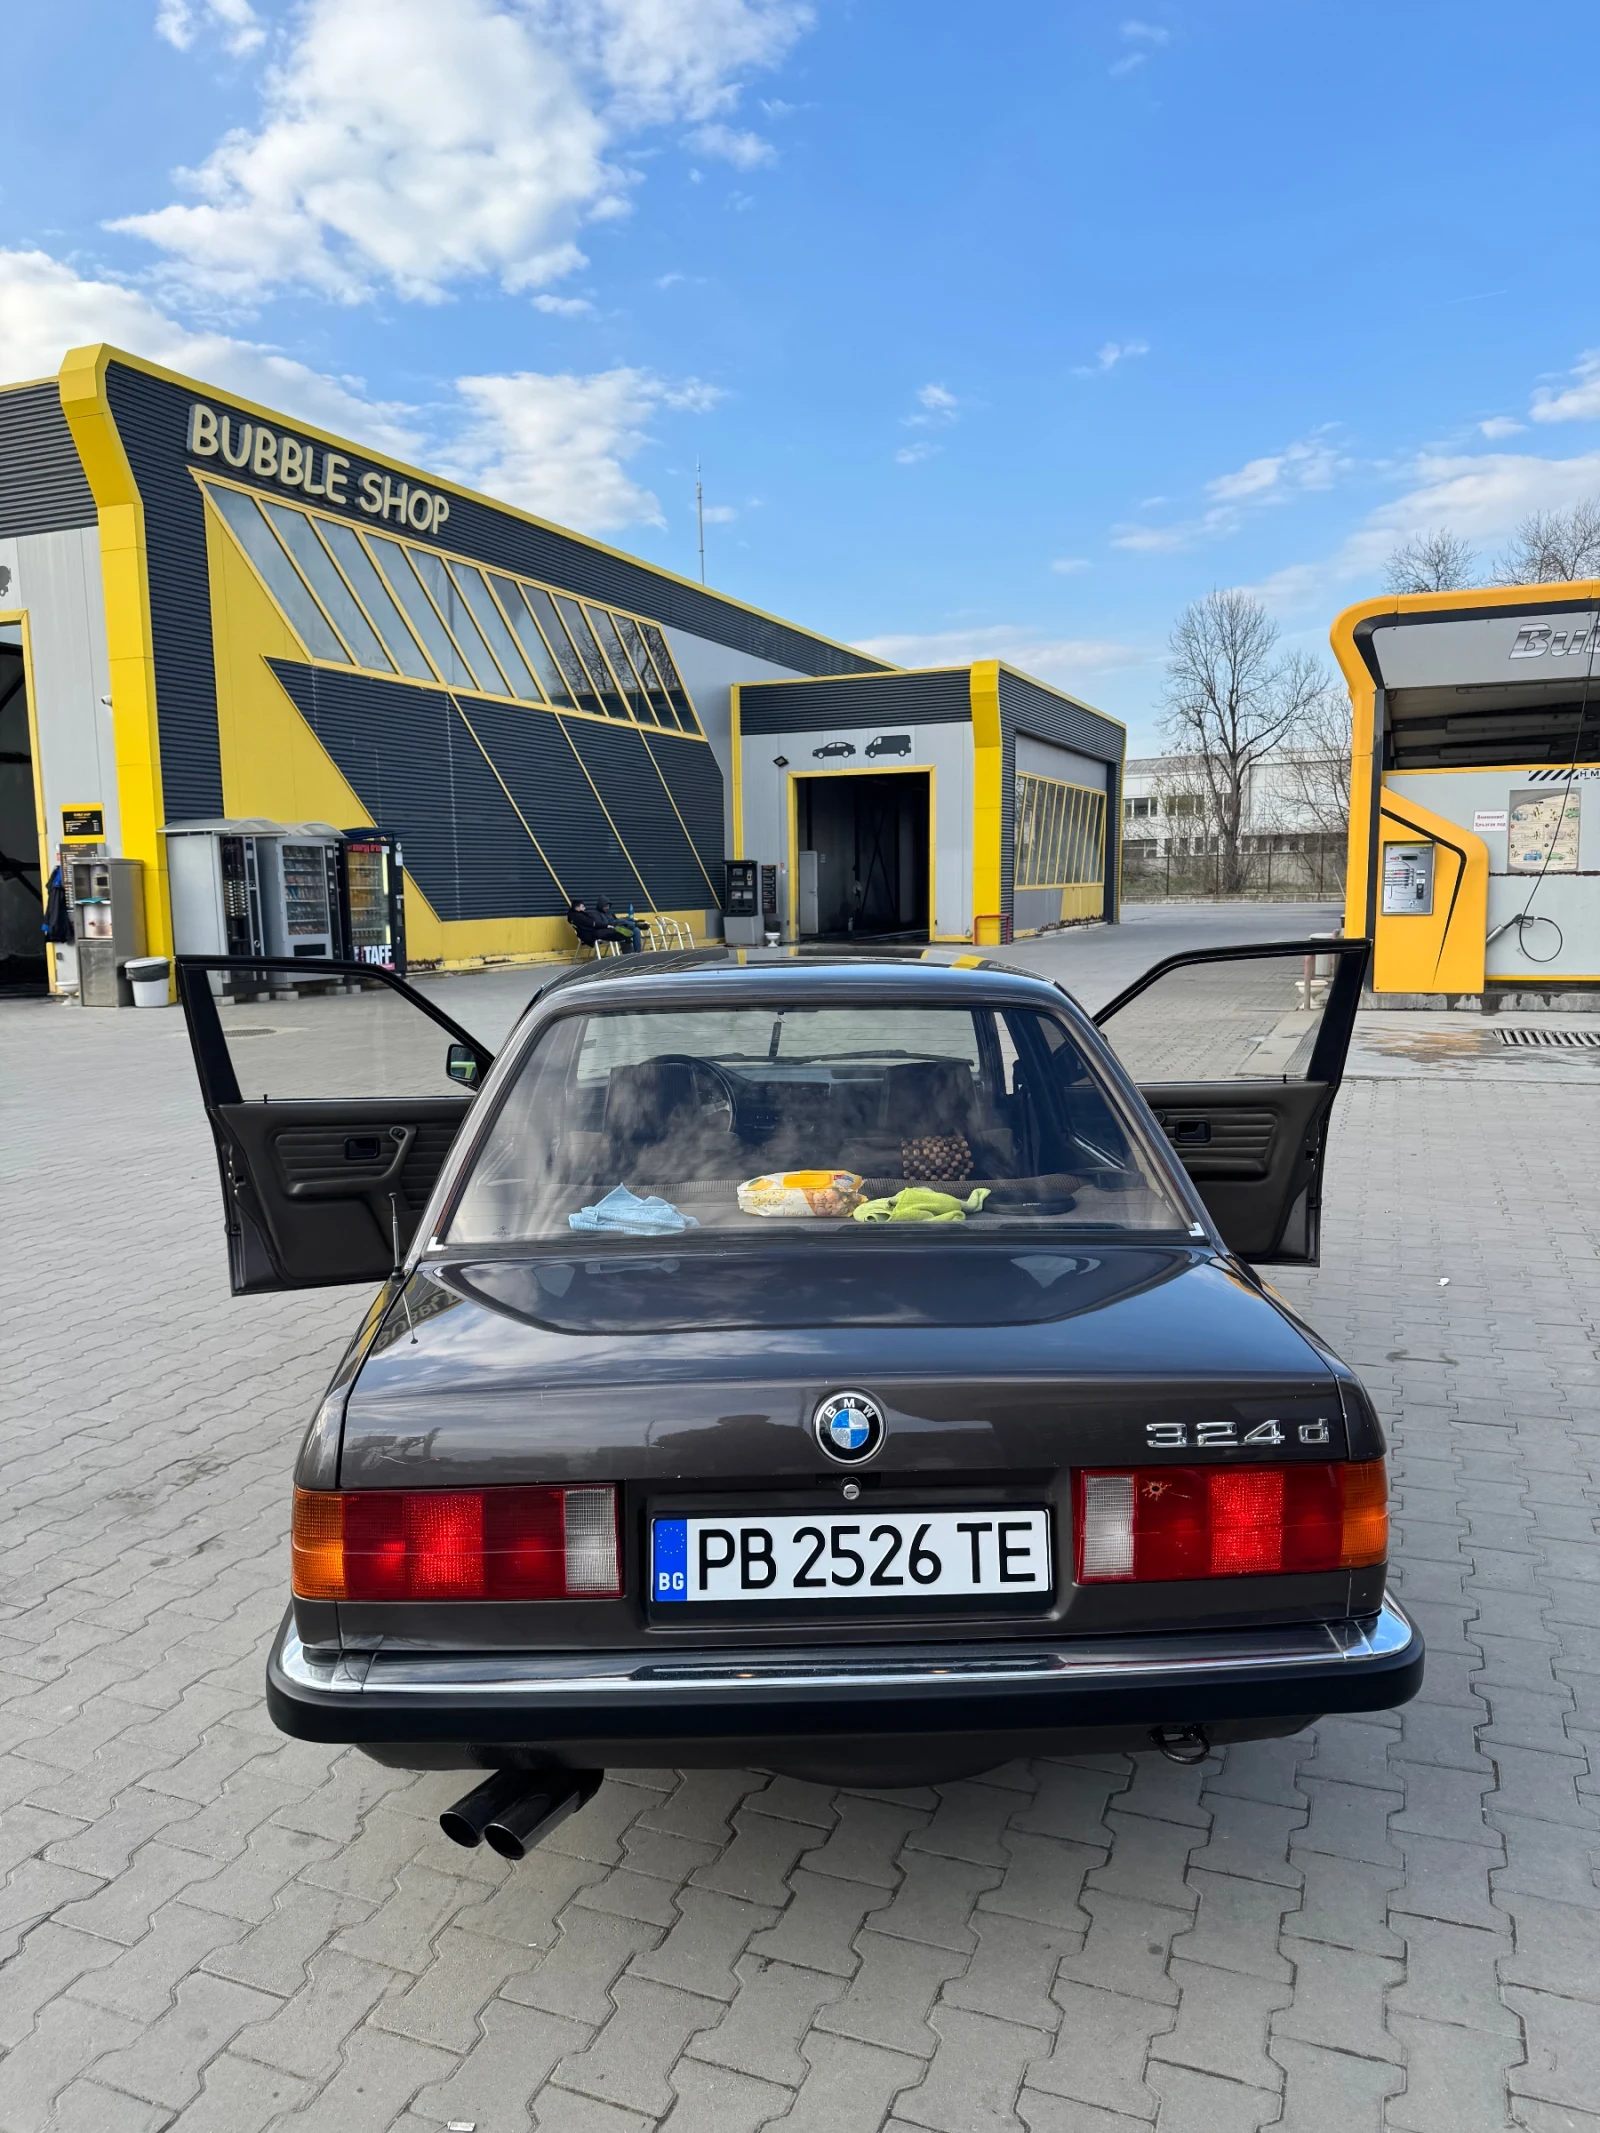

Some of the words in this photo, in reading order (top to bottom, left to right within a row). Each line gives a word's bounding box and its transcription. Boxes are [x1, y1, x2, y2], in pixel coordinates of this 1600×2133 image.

[187, 404, 350, 504] BUBBLE
[355, 472, 450, 534] SHOP
[824, 1398, 876, 1419] BMW
[698, 1528, 777, 1590] PB
[792, 1524, 942, 1587] 2526
[956, 1522, 1036, 1583] TE
[658, 1571, 685, 1591] BG
